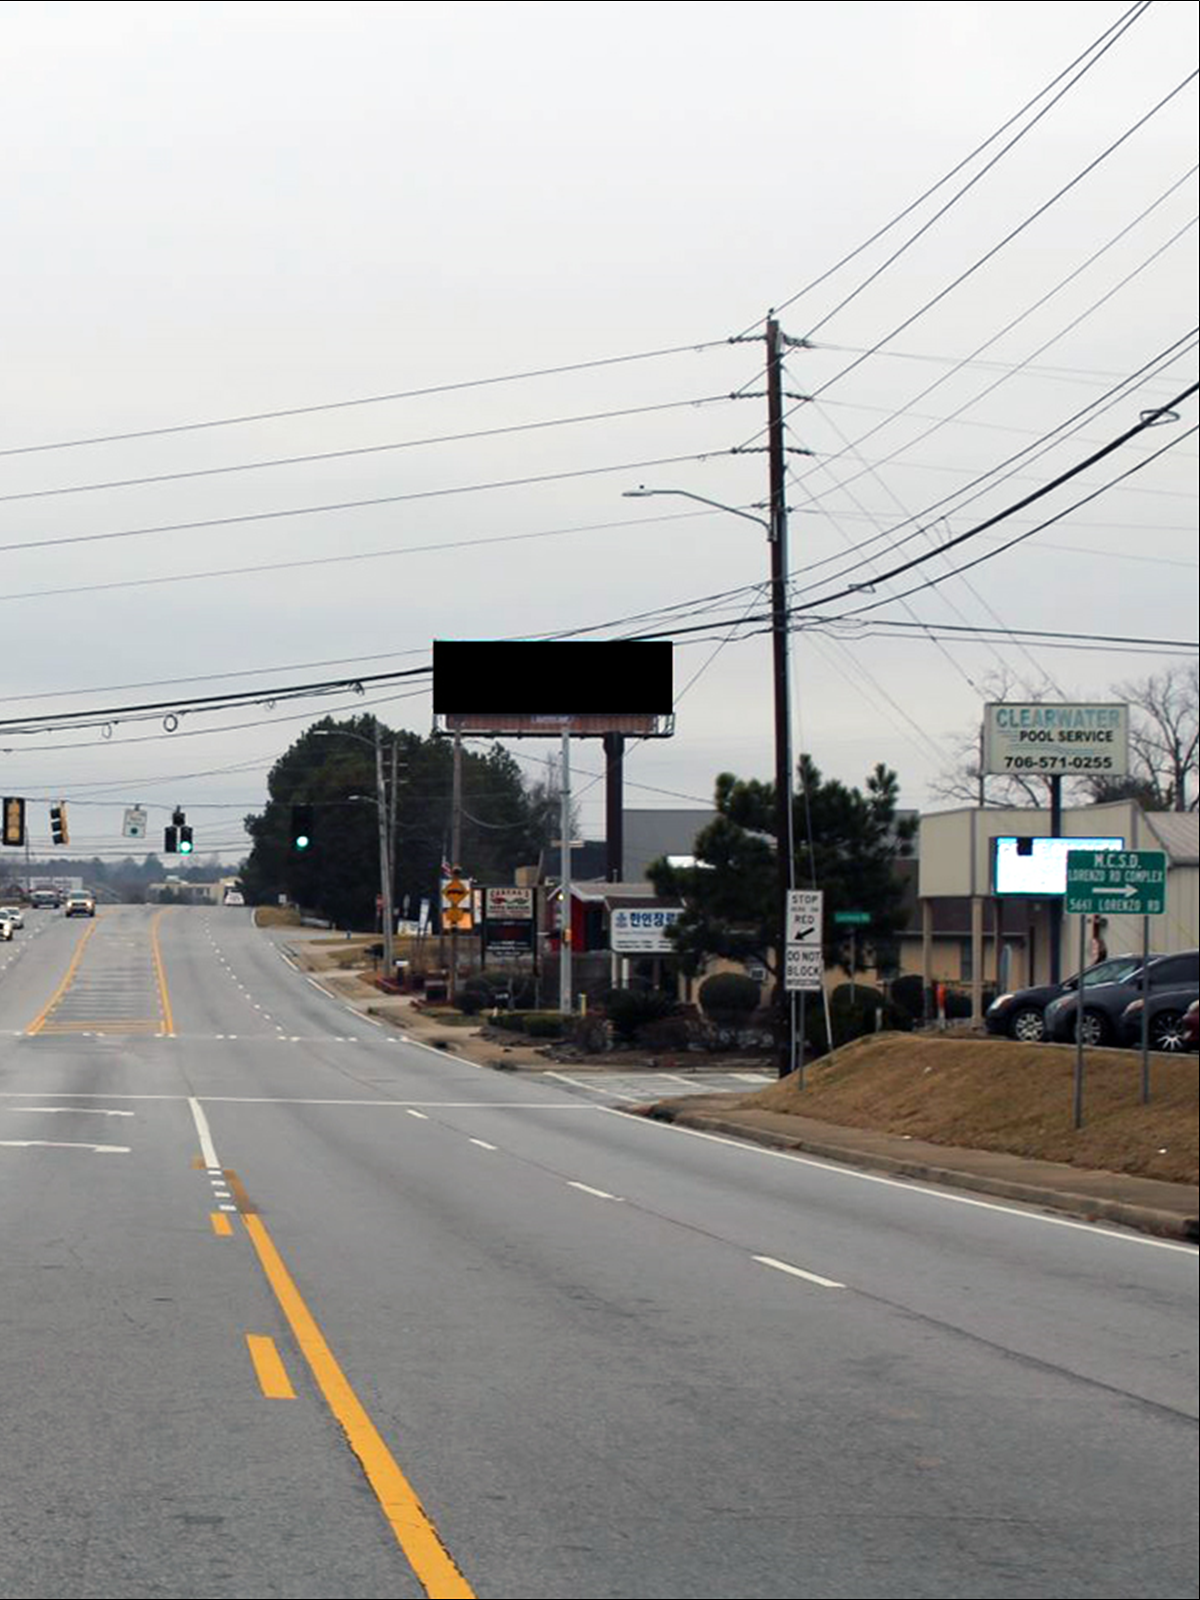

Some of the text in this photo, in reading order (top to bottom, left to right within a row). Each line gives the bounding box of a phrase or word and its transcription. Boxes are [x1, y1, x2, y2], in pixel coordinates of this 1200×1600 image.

[996, 708, 1120, 728] CLEARWATER
[1020, 730, 1113, 742] POOL SERVICE
[1004, 756, 1112, 769] 706-571-0255
[1068, 868, 1163, 883] LORENZO RD COMPLEX
[792, 894, 818, 904] STOP
[1098, 898, 1141, 911] LORENZO
[1147, 899, 1161, 912] RD
[795, 914, 815, 925] RED
[787, 950, 820, 962] DO NOT
[787, 966, 819, 976] BLOCK
